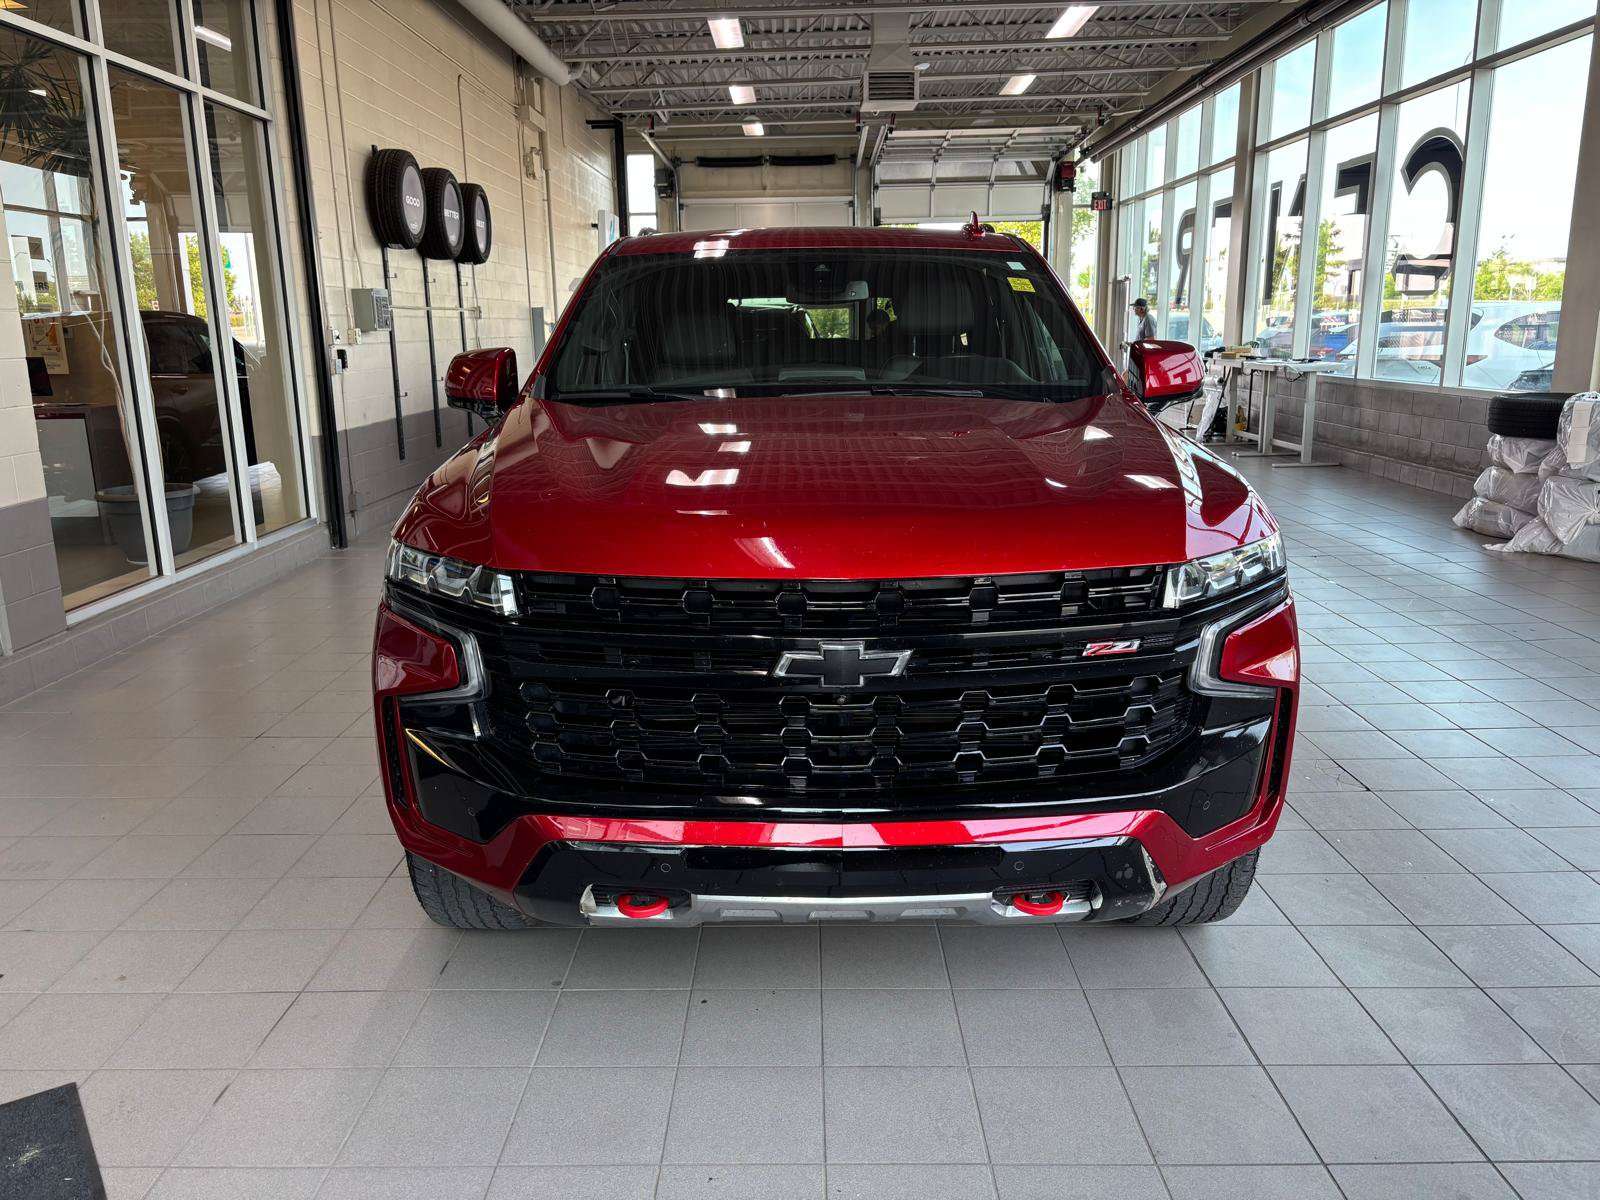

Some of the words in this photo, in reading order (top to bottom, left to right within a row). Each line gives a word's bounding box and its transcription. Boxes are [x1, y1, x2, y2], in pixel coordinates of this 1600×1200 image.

[405, 195, 420, 207] GOOD
[1093, 199, 1107, 209] EXIT
[444, 209, 459, 220] BETTER
[1082, 638, 1141, 656] Z71
